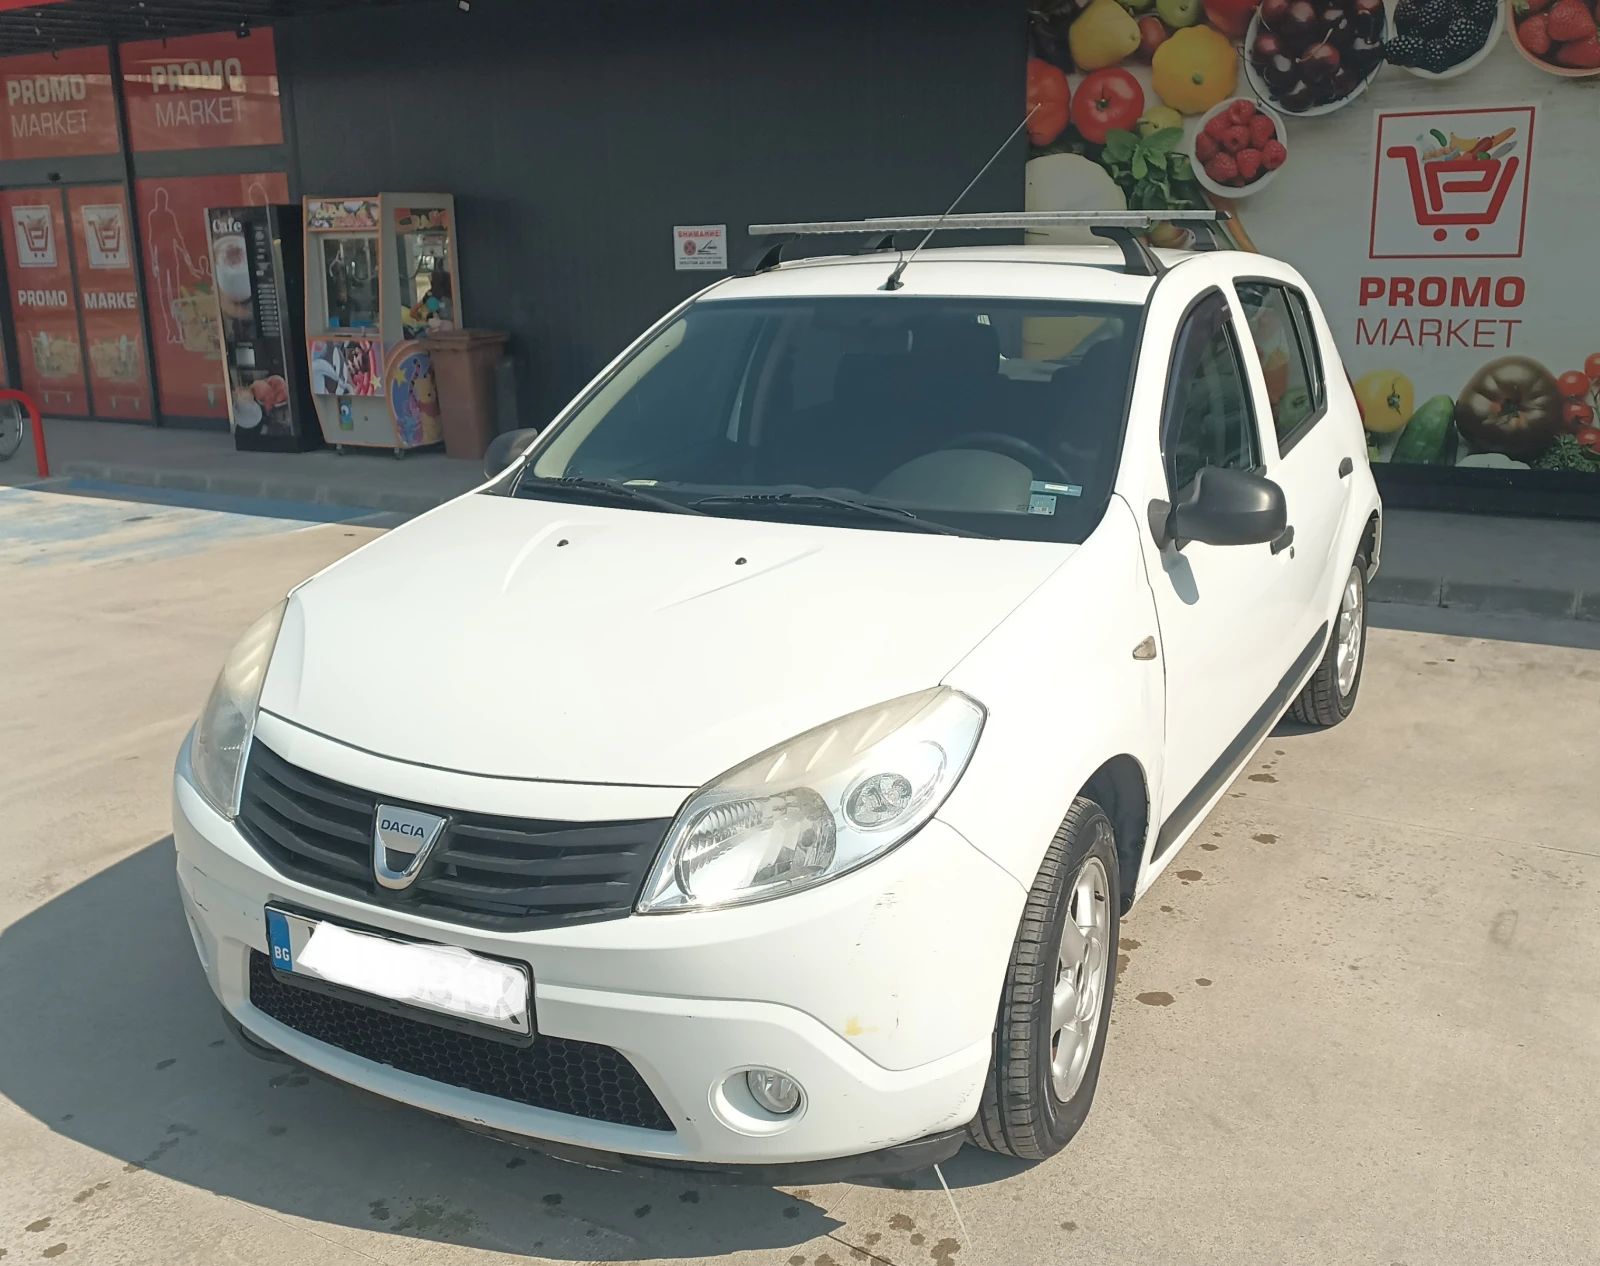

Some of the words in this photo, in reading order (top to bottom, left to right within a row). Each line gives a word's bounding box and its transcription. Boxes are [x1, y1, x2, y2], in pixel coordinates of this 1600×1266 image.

[7, 75, 86, 106] PROMO
[151, 58, 243, 93] PROMO
[11, 109, 88, 138] MARKET
[155, 96, 244, 127] MARKET
[212, 217, 243, 234] Cafe
[18, 290, 68, 307] PROMO
[84, 292, 138, 309] MARKE
[1358, 276, 1526, 307] PROMO
[1355, 317, 1522, 348] MARKET
[380, 819, 425, 839] DACIA
[274, 945, 291, 963] BG
